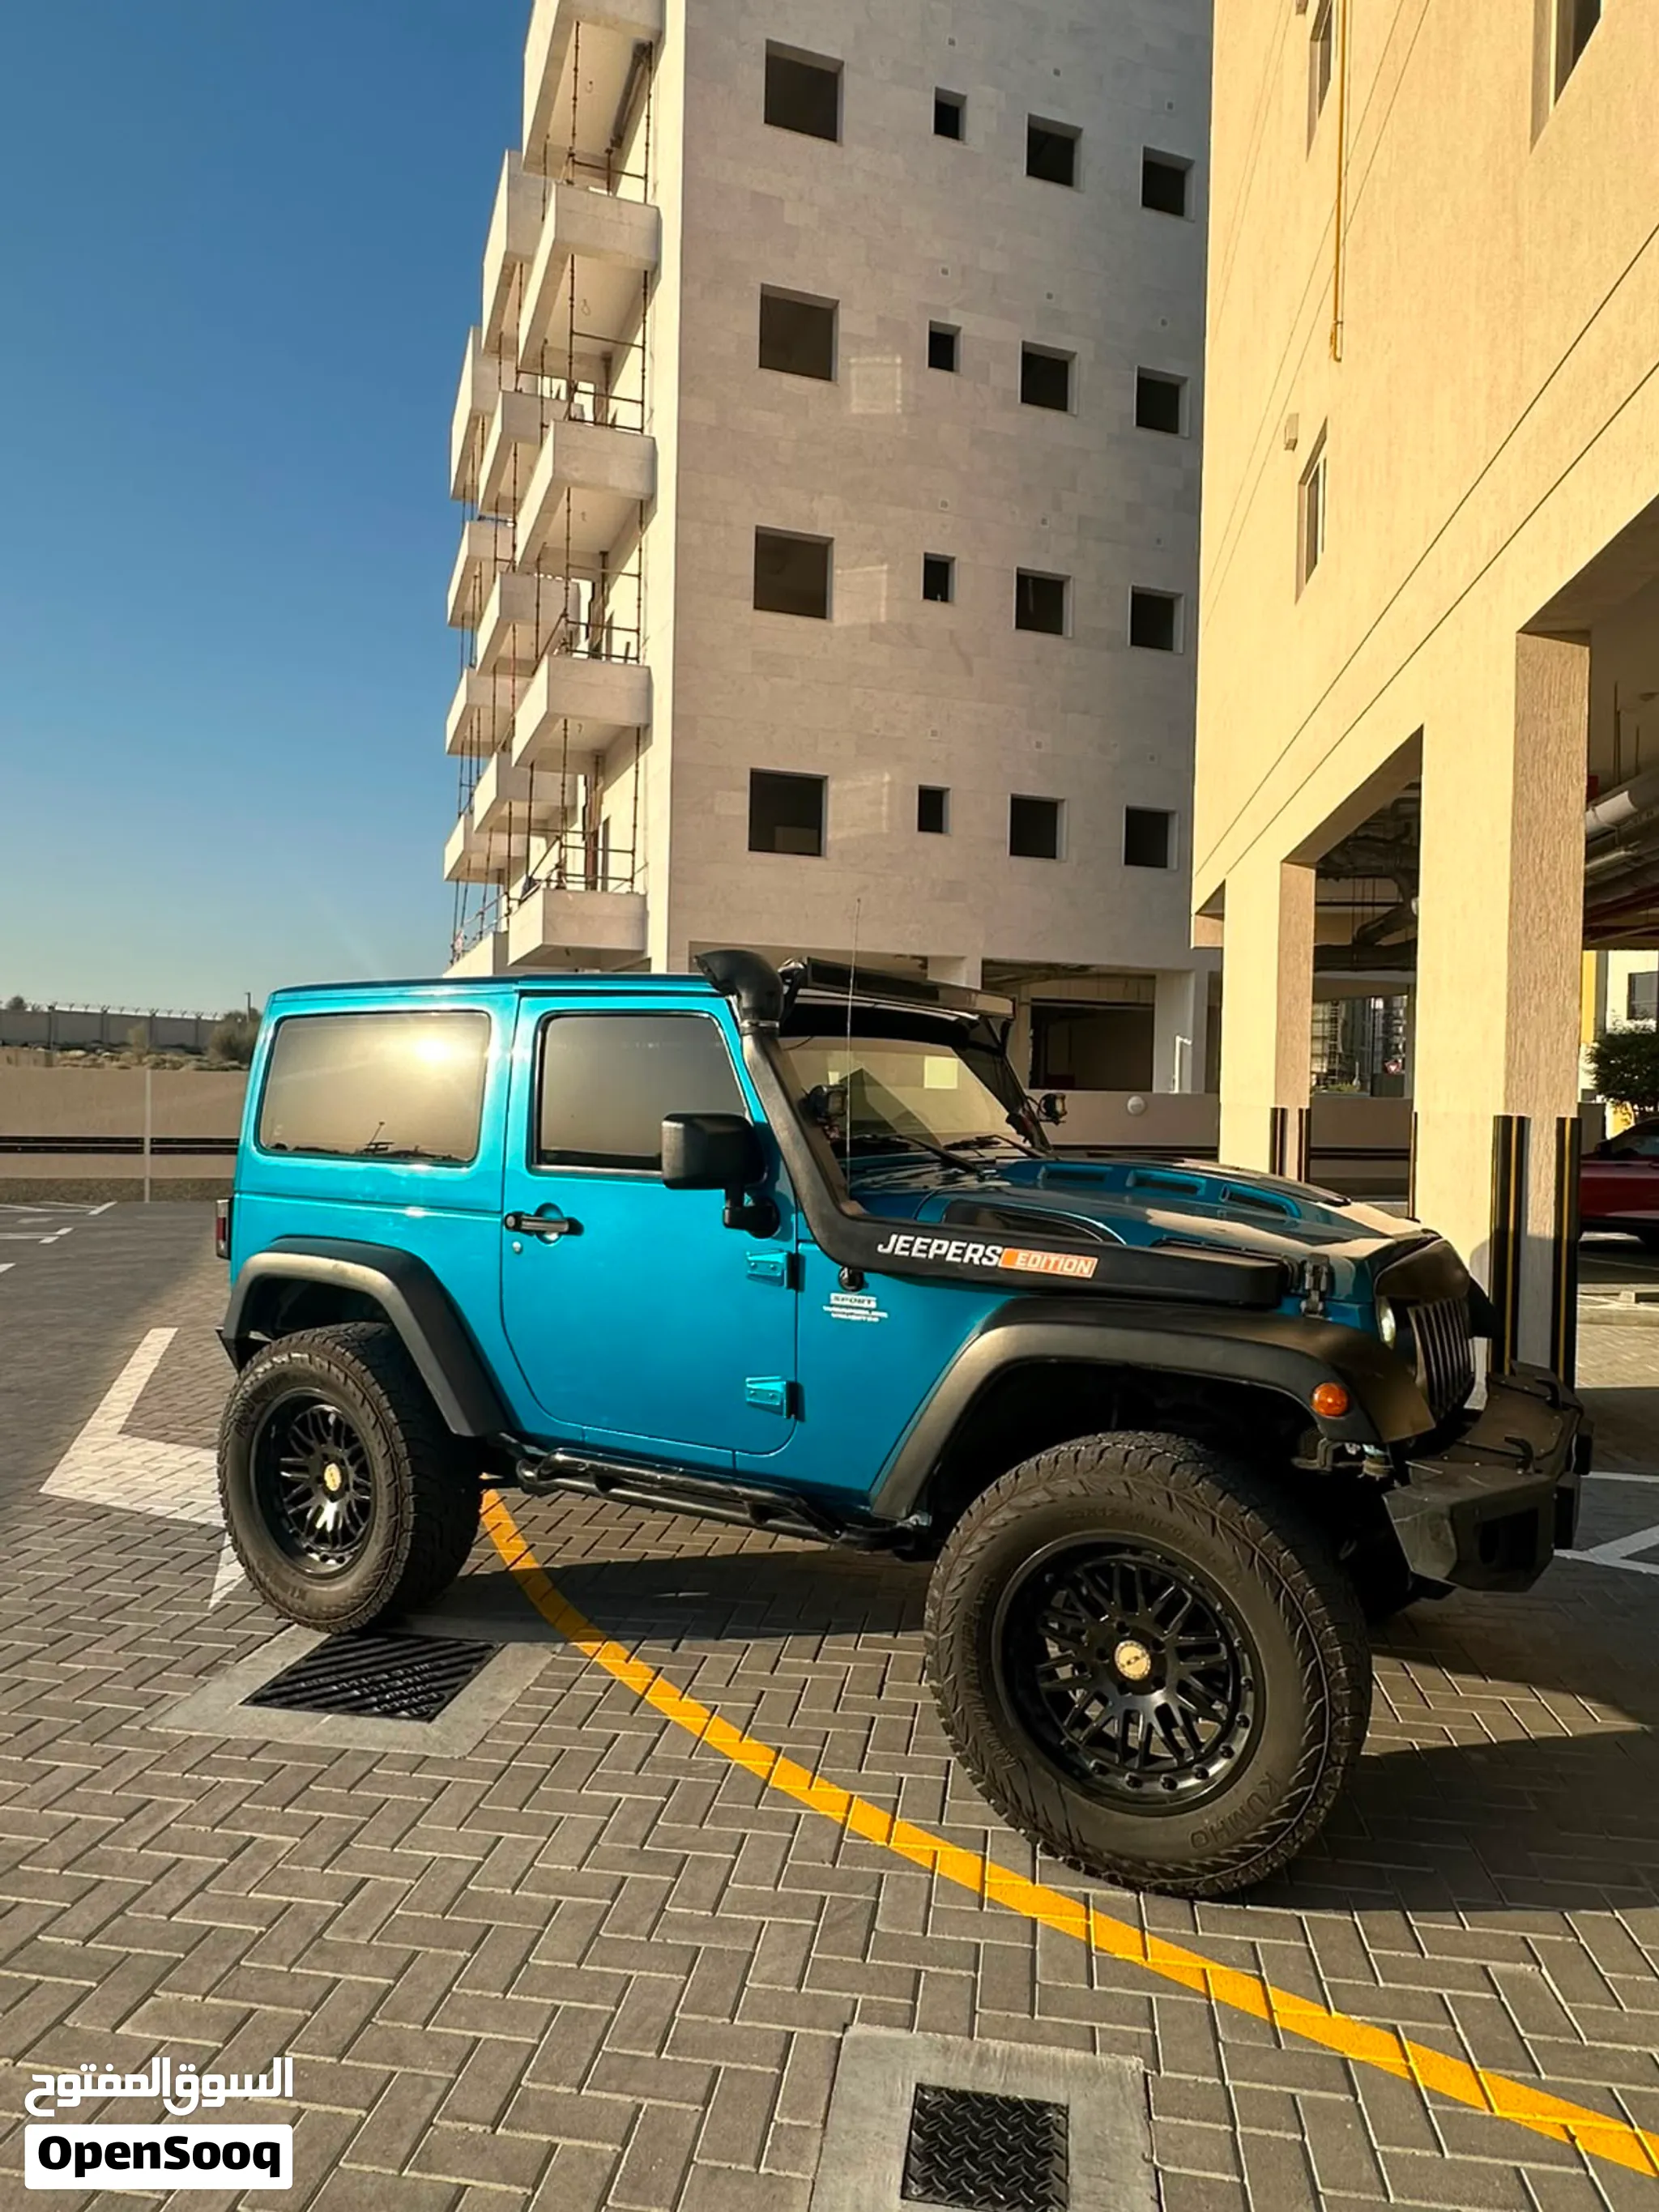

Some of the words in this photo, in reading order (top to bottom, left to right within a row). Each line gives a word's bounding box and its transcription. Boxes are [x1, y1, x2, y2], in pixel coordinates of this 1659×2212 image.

[877, 1234, 1003, 1268] JEEPERS
[1015, 1251, 1094, 1276] EDITION
[1189, 1771, 1278, 1849] KUMHO
